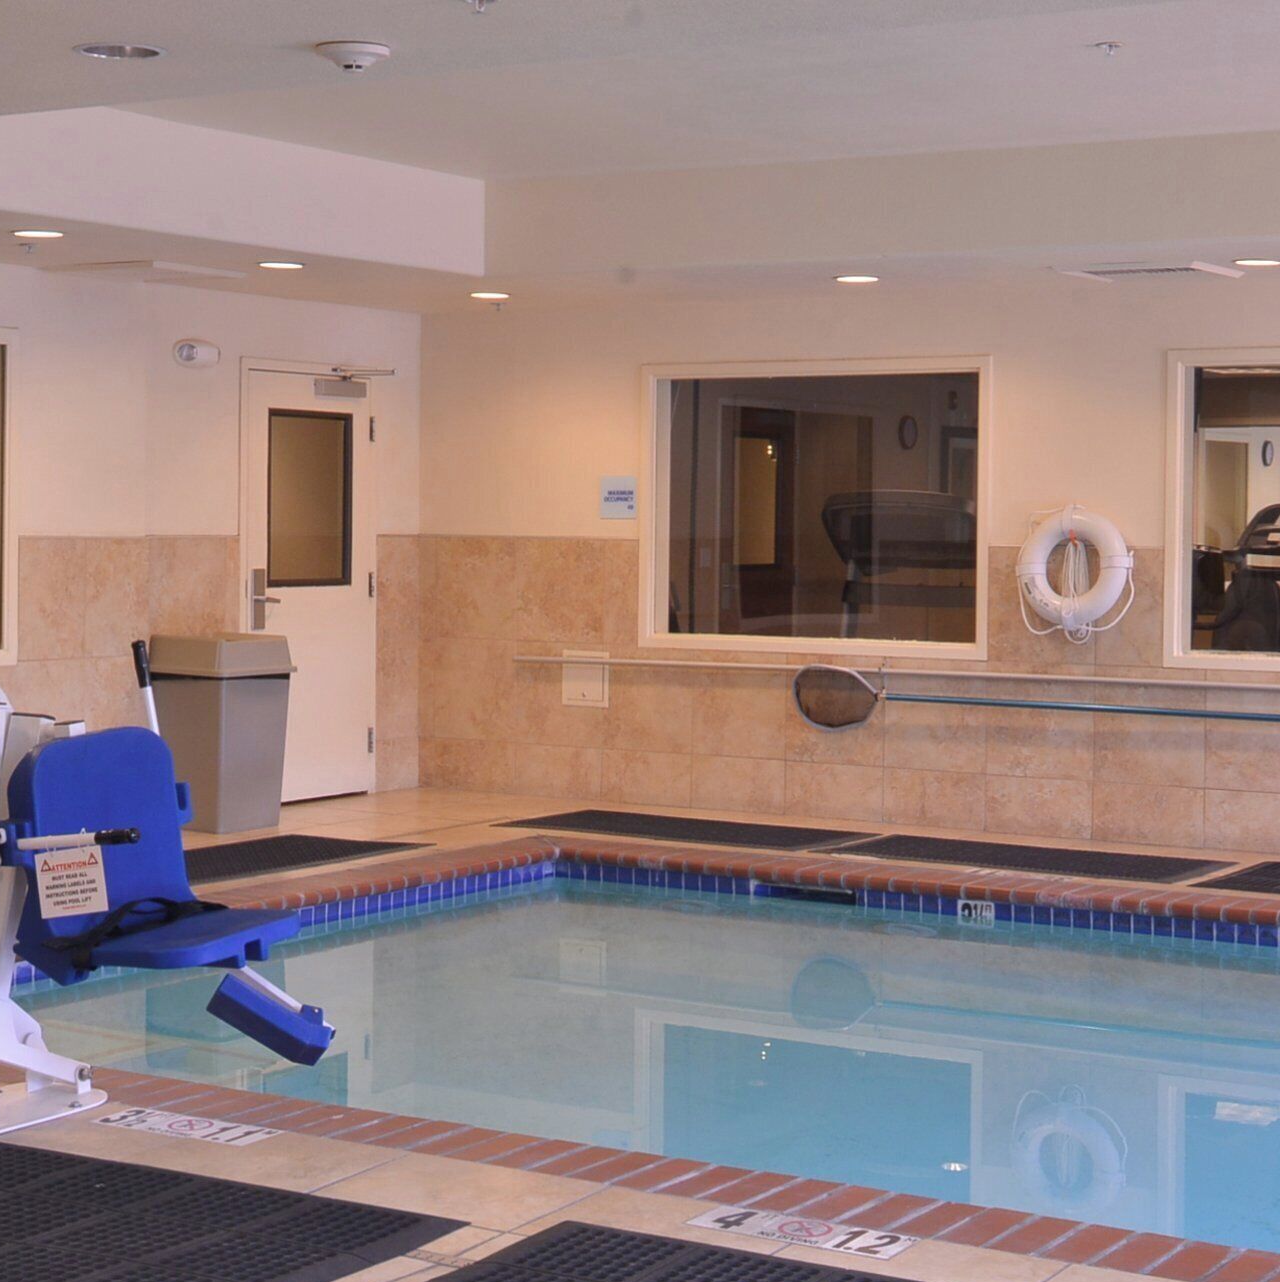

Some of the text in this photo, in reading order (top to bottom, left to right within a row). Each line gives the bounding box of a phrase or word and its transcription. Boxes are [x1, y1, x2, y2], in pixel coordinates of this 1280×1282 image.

[50, 861, 87, 871] ATTENTION
[712, 1211, 759, 1229] 4
[777, 1234, 819, 1246] DIVING
[832, 1229, 902, 1254] 1.2
